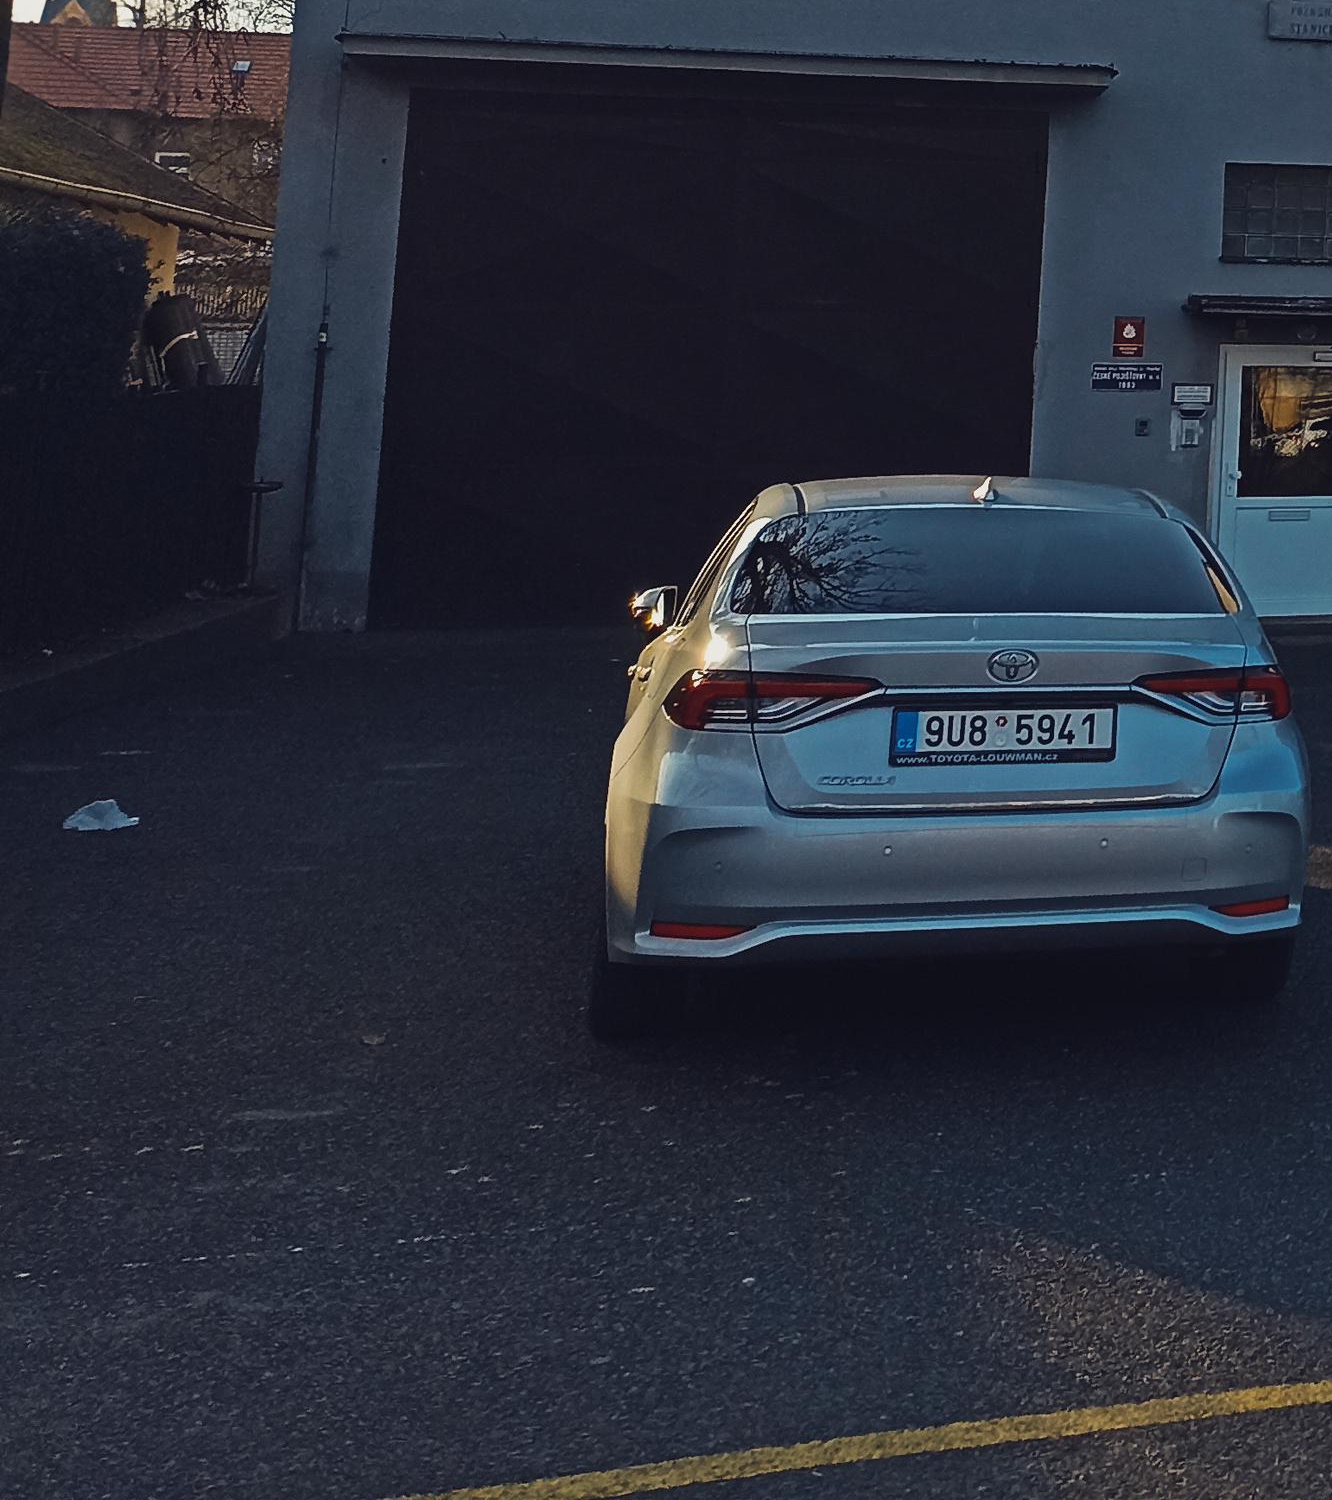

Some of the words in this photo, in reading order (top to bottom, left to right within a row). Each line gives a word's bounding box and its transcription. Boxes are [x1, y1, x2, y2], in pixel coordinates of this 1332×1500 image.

[924, 714, 988, 748] 9U8
[1014, 712, 1097, 746] 5941
[896, 737, 914, 750] CZ
